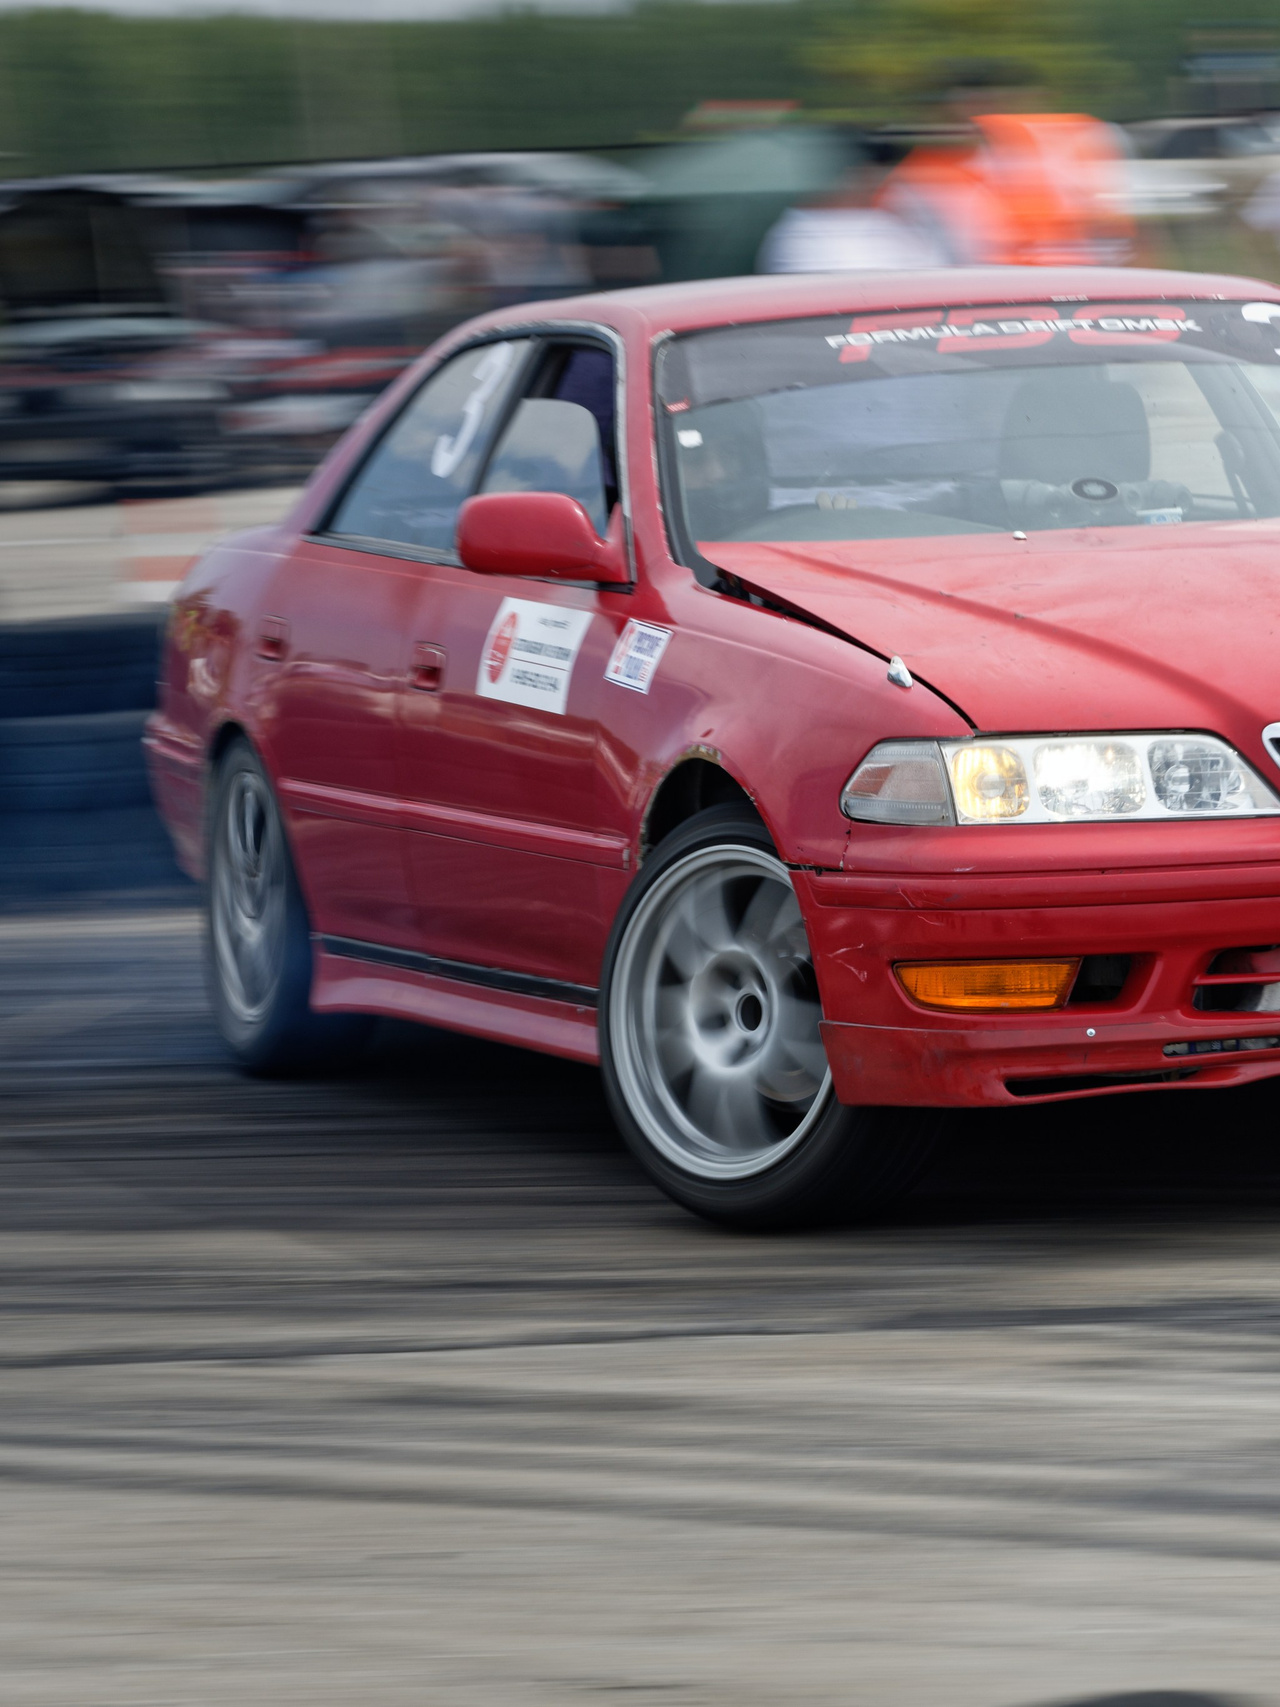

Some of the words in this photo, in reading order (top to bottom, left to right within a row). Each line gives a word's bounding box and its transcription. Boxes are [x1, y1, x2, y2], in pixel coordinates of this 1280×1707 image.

[824, 321, 998, 349] FORMULA
[997, 318, 1095, 335] DRIFT
[1098, 318, 1204, 333] OMSK
